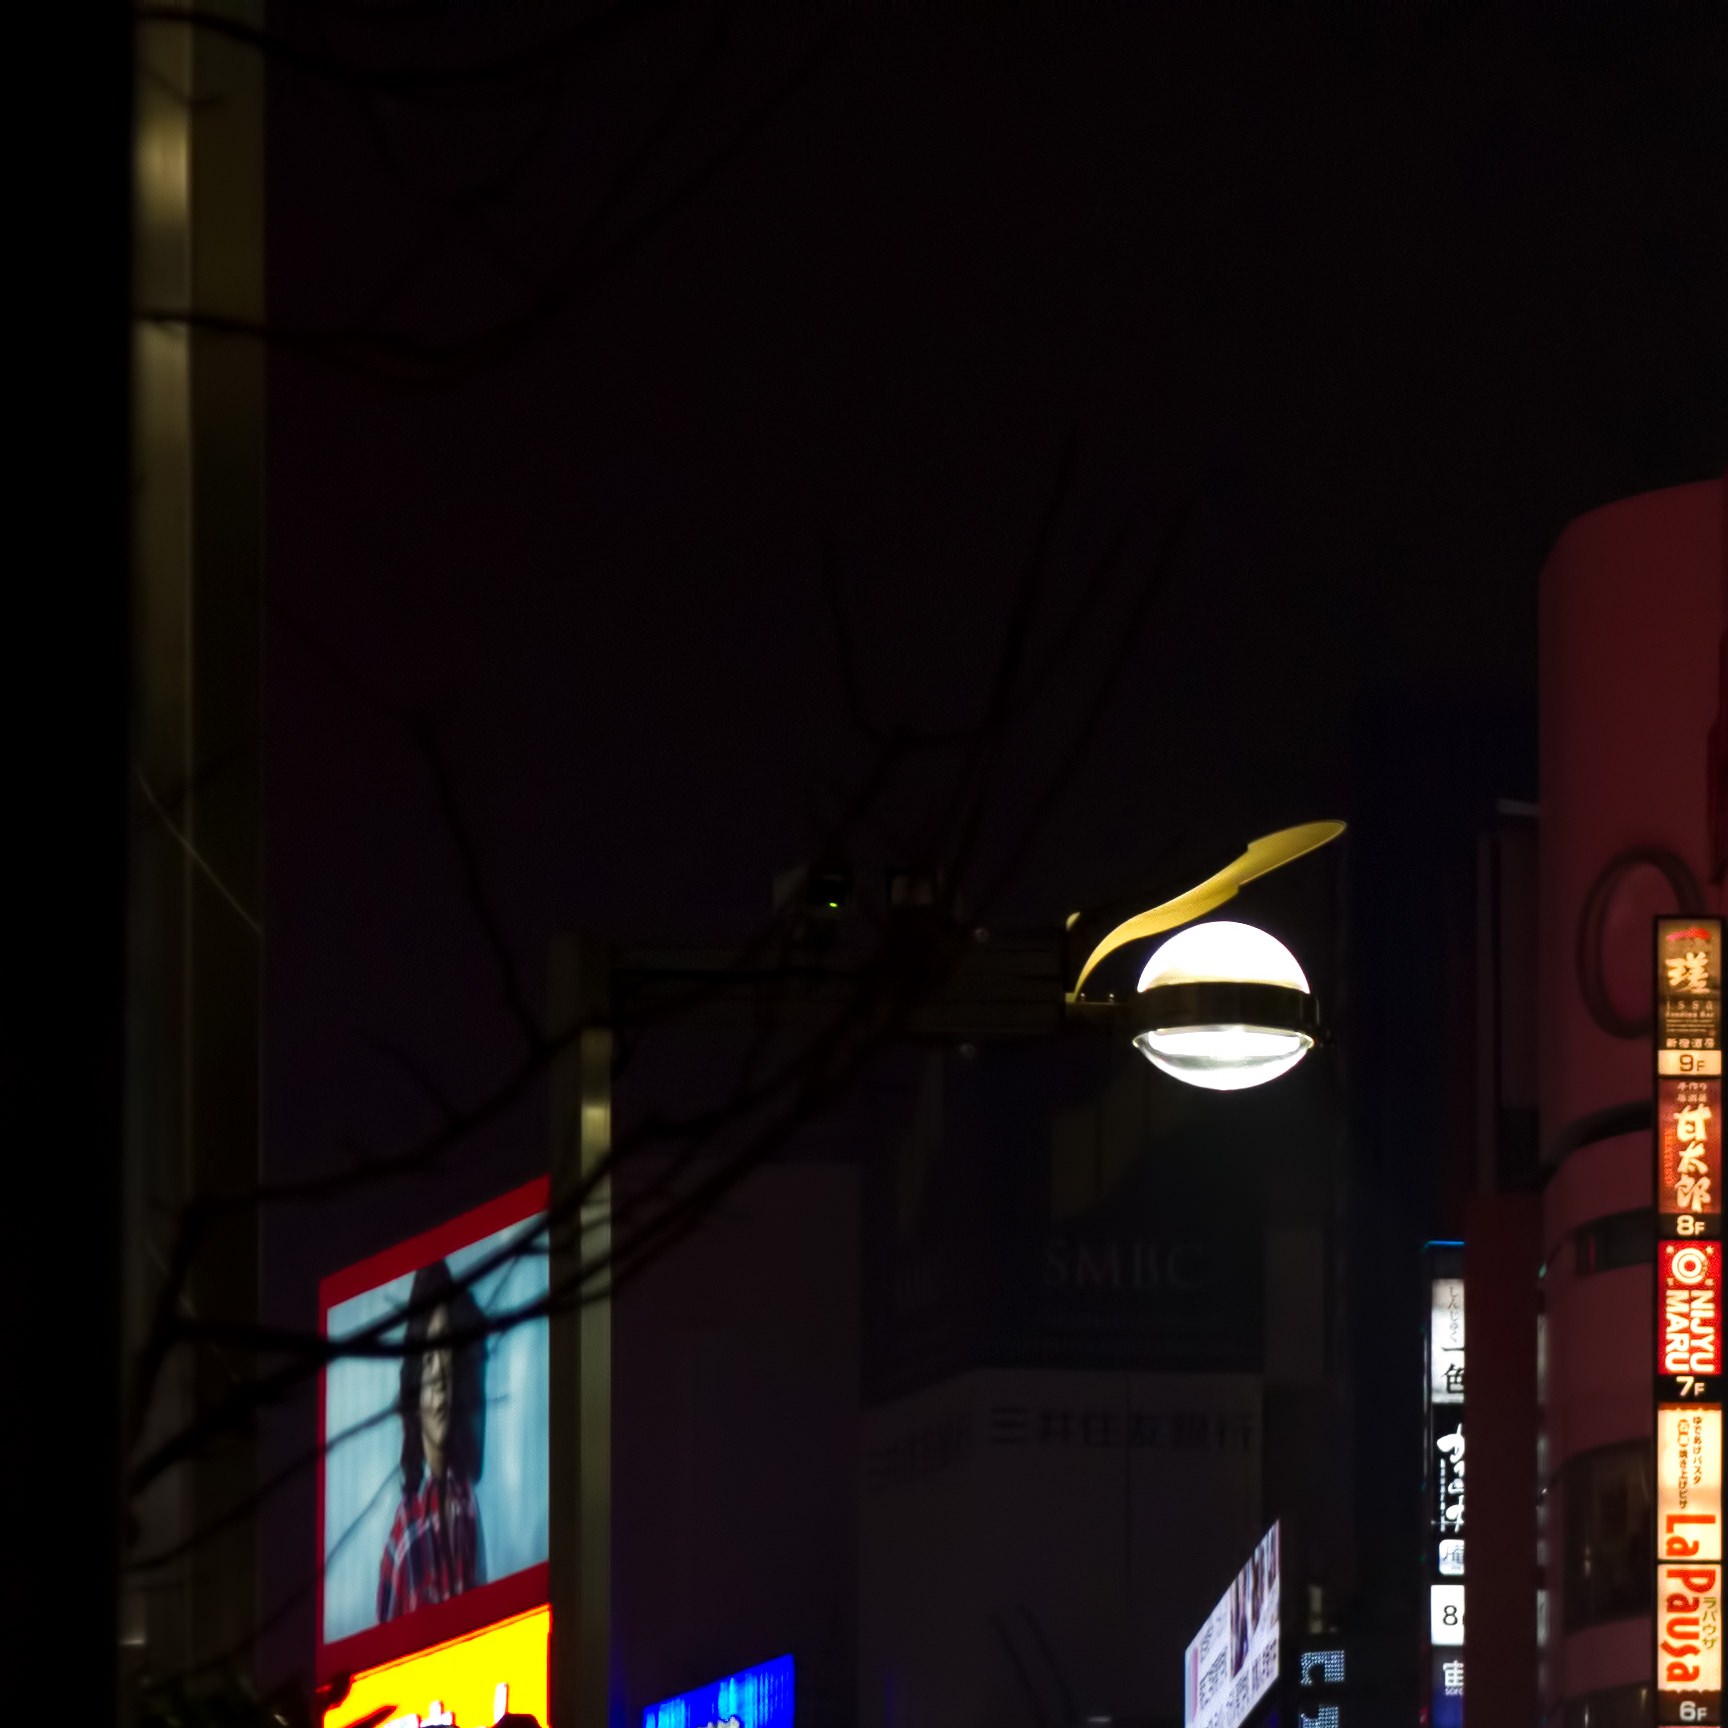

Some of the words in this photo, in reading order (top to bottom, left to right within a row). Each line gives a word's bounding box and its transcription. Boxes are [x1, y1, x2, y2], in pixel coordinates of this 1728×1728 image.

[1680, 1054, 1706, 1072] 9F
[1676, 1214, 1705, 1236] 8F
[1665, 1290, 1690, 1373] MARU
[1690, 1290, 1715, 1373] NIJYU
[1676, 1375, 1705, 1397] 7F
[1665, 1513, 1716, 1558] La
[1679, 1701, 1708, 1721] 6F
